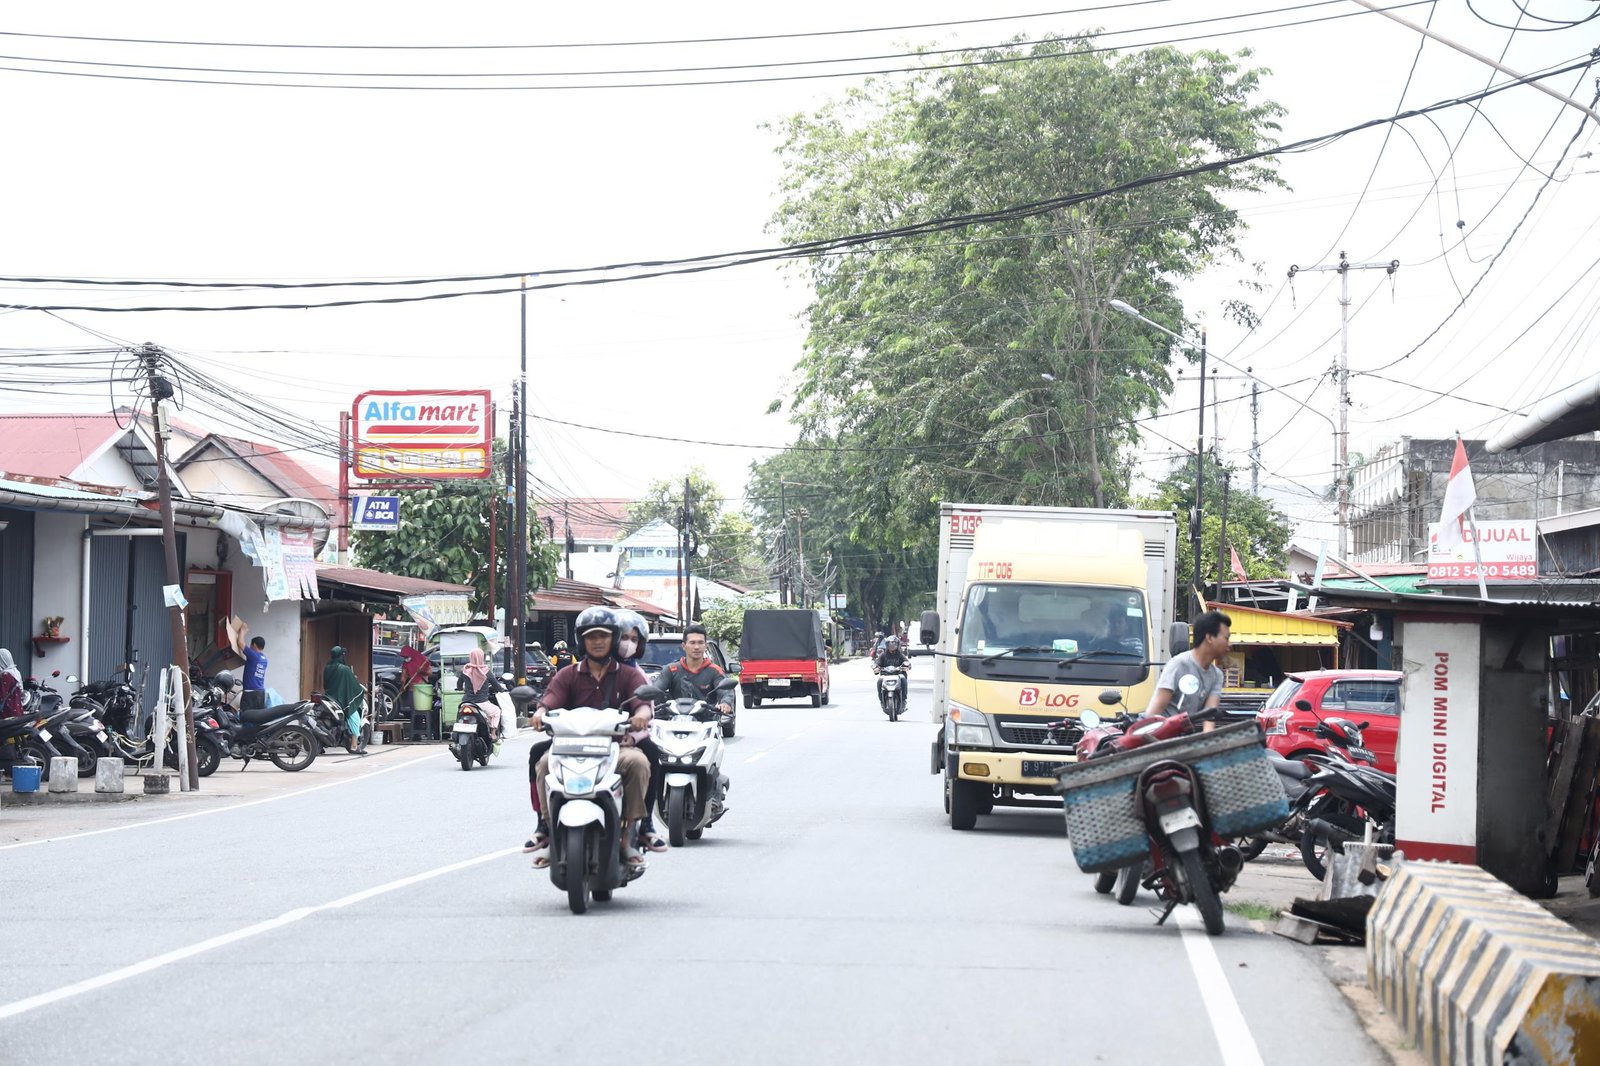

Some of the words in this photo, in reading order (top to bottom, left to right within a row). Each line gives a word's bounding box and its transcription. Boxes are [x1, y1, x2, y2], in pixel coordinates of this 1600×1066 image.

[365, 401, 479, 422] Alfamart
[368, 502, 390, 510] ATM
[375, 511, 394, 520] BCA
[1463, 528, 1531, 543] DIJUAL
[1506, 554, 1533, 562] Wijaya
[979, 562, 994, 579] TTP
[1429, 566, 1460, 577] 0812
[1502, 565, 1536, 576] 5489
[1434, 652, 1449, 691] POM
[1045, 694, 1080, 708] LOG
[1433, 698, 1448, 736] MINI
[1431, 743, 1447, 813] DIGITAL
